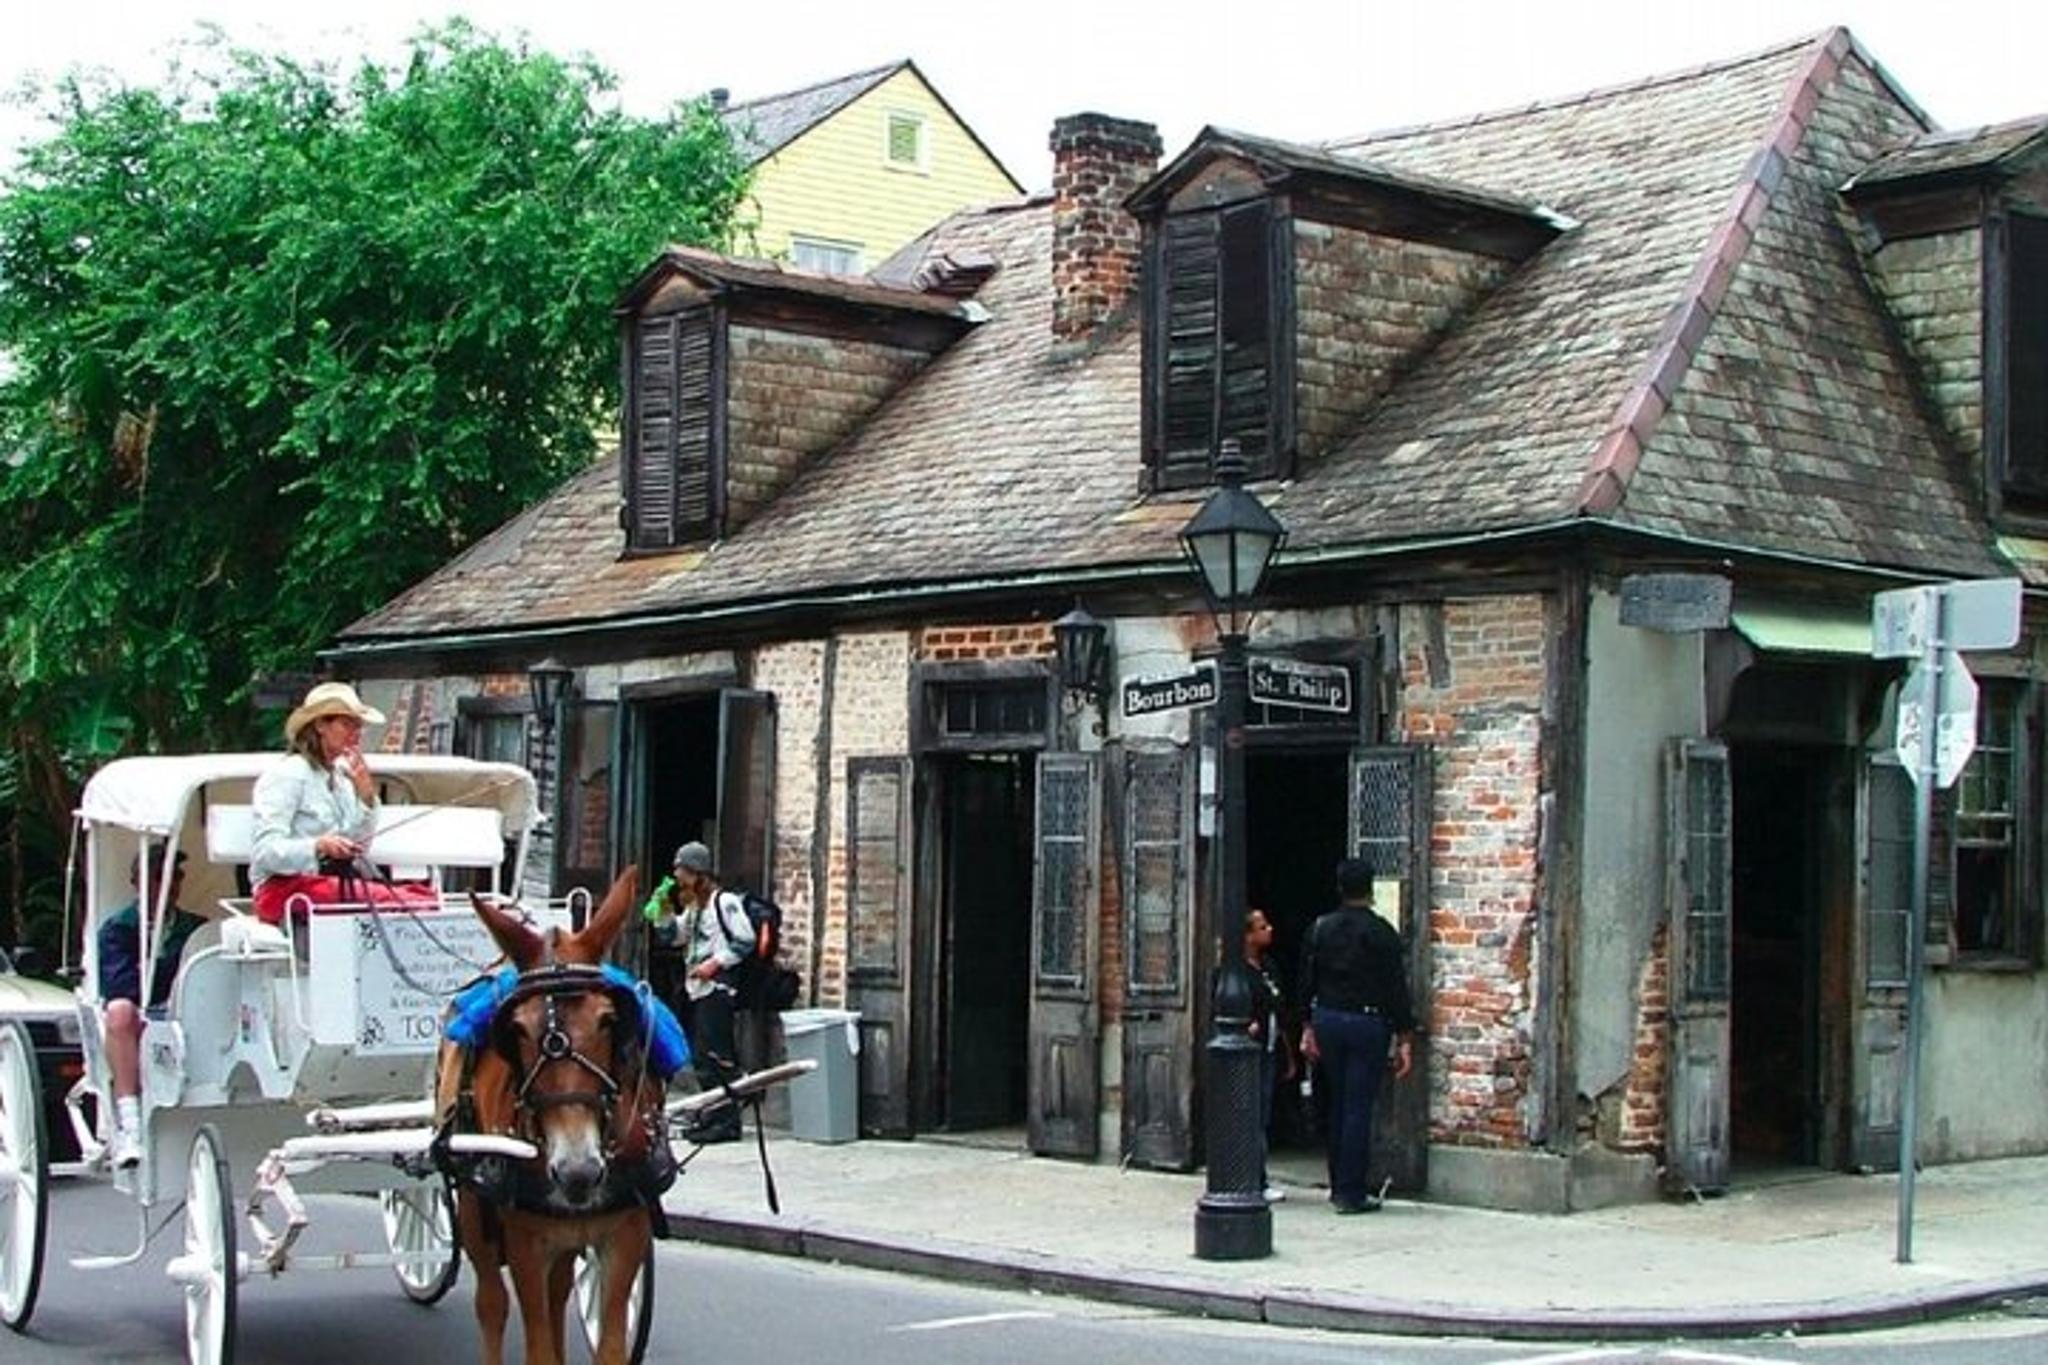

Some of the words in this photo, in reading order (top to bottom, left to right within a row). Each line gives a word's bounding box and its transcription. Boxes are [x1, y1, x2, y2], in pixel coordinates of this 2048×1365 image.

[1126, 681, 1213, 712] Bourbon
[1256, 671, 1280, 693] St.
[1287, 675, 1342, 707] Philip
